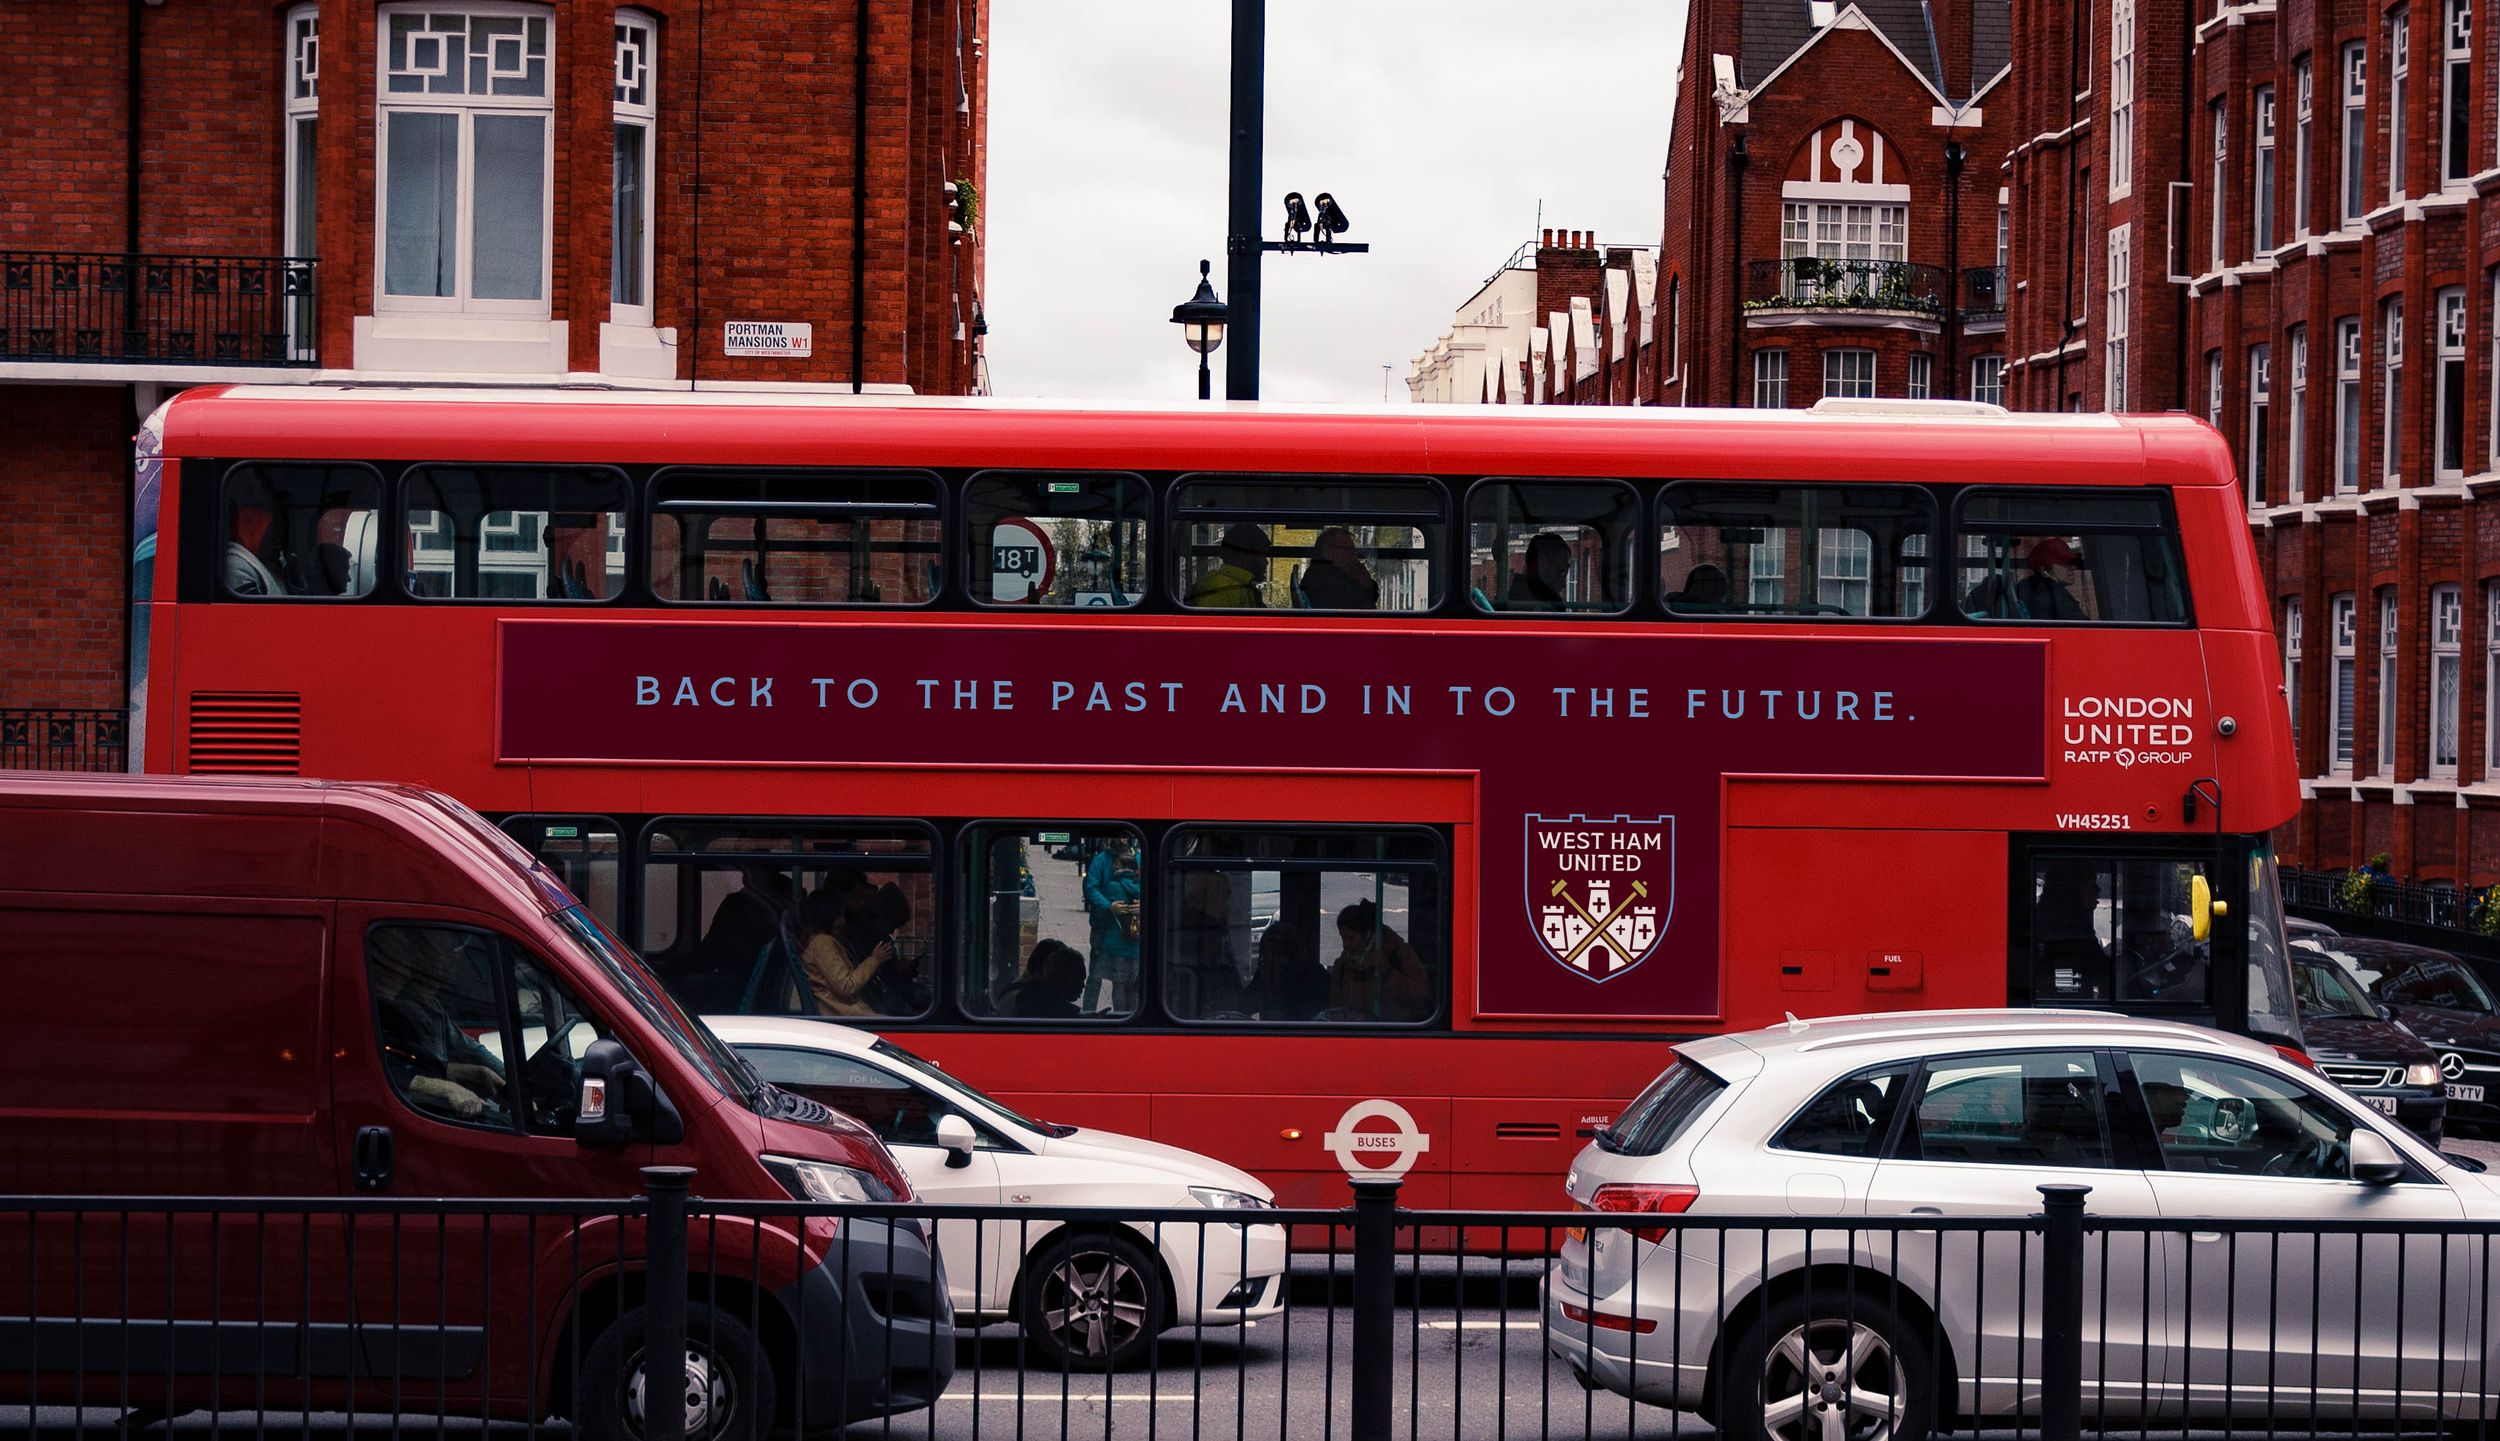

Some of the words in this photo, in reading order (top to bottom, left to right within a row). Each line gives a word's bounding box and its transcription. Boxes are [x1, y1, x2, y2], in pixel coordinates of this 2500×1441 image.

[728, 323, 783, 336] PORTMAN
[728, 336, 788, 349] MANSIONS
[791, 337, 808, 349] W1
[636, 676, 775, 708] BACK
[811, 678, 880, 709] TO
[915, 680, 1014, 711] THE
[1051, 682, 1184, 713] PAST
[1219, 684, 1326, 714] AND
[1363, 685, 1411, 715] IN
[1448, 686, 1516, 718] TO
[1552, 688, 1650, 719] THE
[1687, 690, 1916, 721] FUTURE.
[2064, 697, 2193, 718] LONDON
[2064, 724, 2193, 745] UNITED
[2064, 751, 2111, 763] RATP
[2137, 752, 2192, 764] GROUP
[2056, 814, 2131, 829] VH45251
[1538, 832, 1604, 850] WEST
[1611, 833, 1662, 850] HAM
[1559, 854, 1642, 872] UNITED
[1884, 955, 1902, 963] FUEL
[849, 1075, 868, 1084] FOR
[2459, 1086, 2482, 1099] YTV
[1581, 1116, 1609, 1124] AdBLUE
[1357, 1137, 1396, 1147] BUSES
